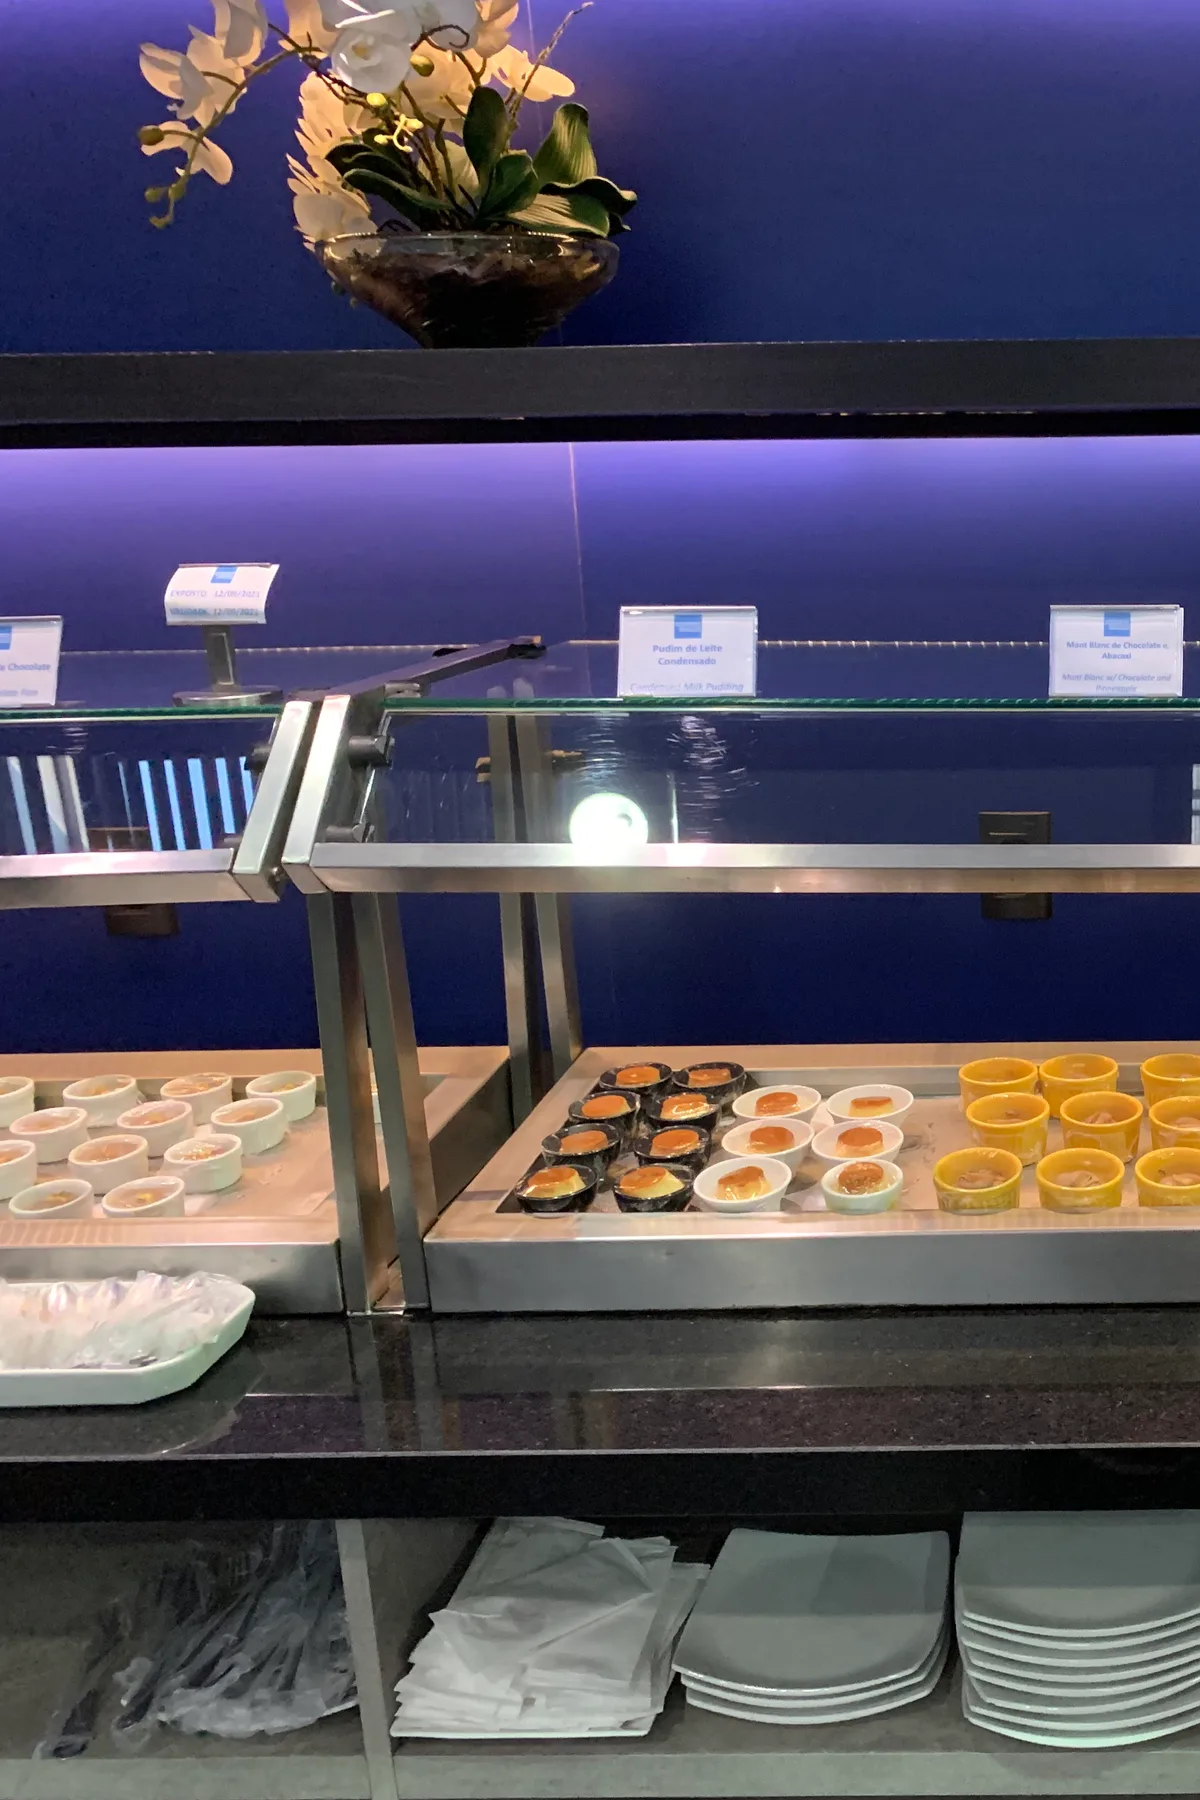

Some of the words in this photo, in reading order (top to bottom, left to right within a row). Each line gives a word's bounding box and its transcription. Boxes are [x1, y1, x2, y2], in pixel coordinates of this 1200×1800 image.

[652, 644, 683, 653] Pudim
[685, 644, 698, 653] de
[700, 644, 723, 653] Leite
[1066, 641, 1088, 649] Mont
[1089, 641, 1110, 649] Blanc
[1123, 641, 1161, 650] Chocolate
[1102, 652, 1132, 660] Abacaxi
[658, 657, 716, 666] Condensado
[684, 682, 702, 691] Milk
[705, 683, 744, 692] Pudding
